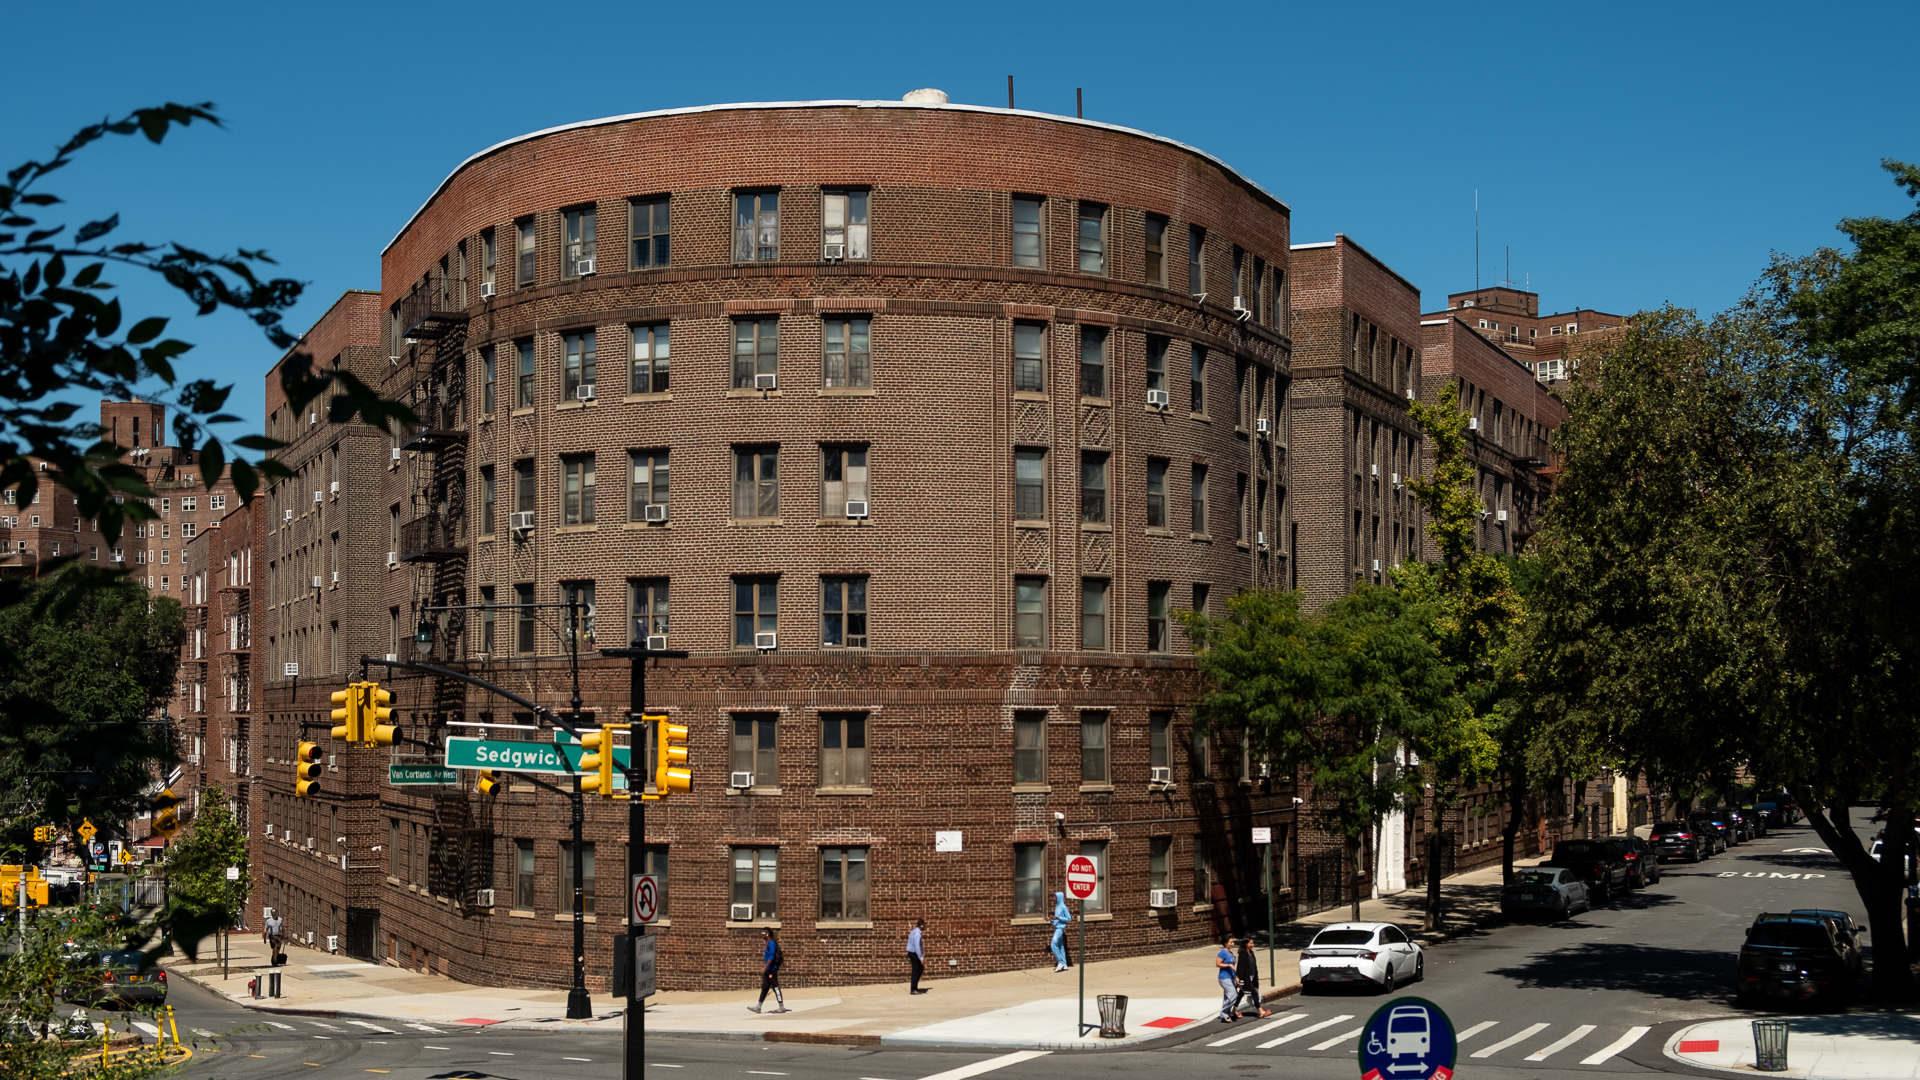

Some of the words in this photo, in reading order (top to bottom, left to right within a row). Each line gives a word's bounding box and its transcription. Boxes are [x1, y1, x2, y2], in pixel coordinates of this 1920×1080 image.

[475, 746, 566, 768] Sedgwick
[391, 770, 404, 779] Van
[405, 770, 432, 779] Cortlandt
[443, 770, 456, 779] West
[1716, 871, 1826, 880] BUMP
[1073, 883, 1090, 891] ENTER
[641, 960, 651, 973] MUST
